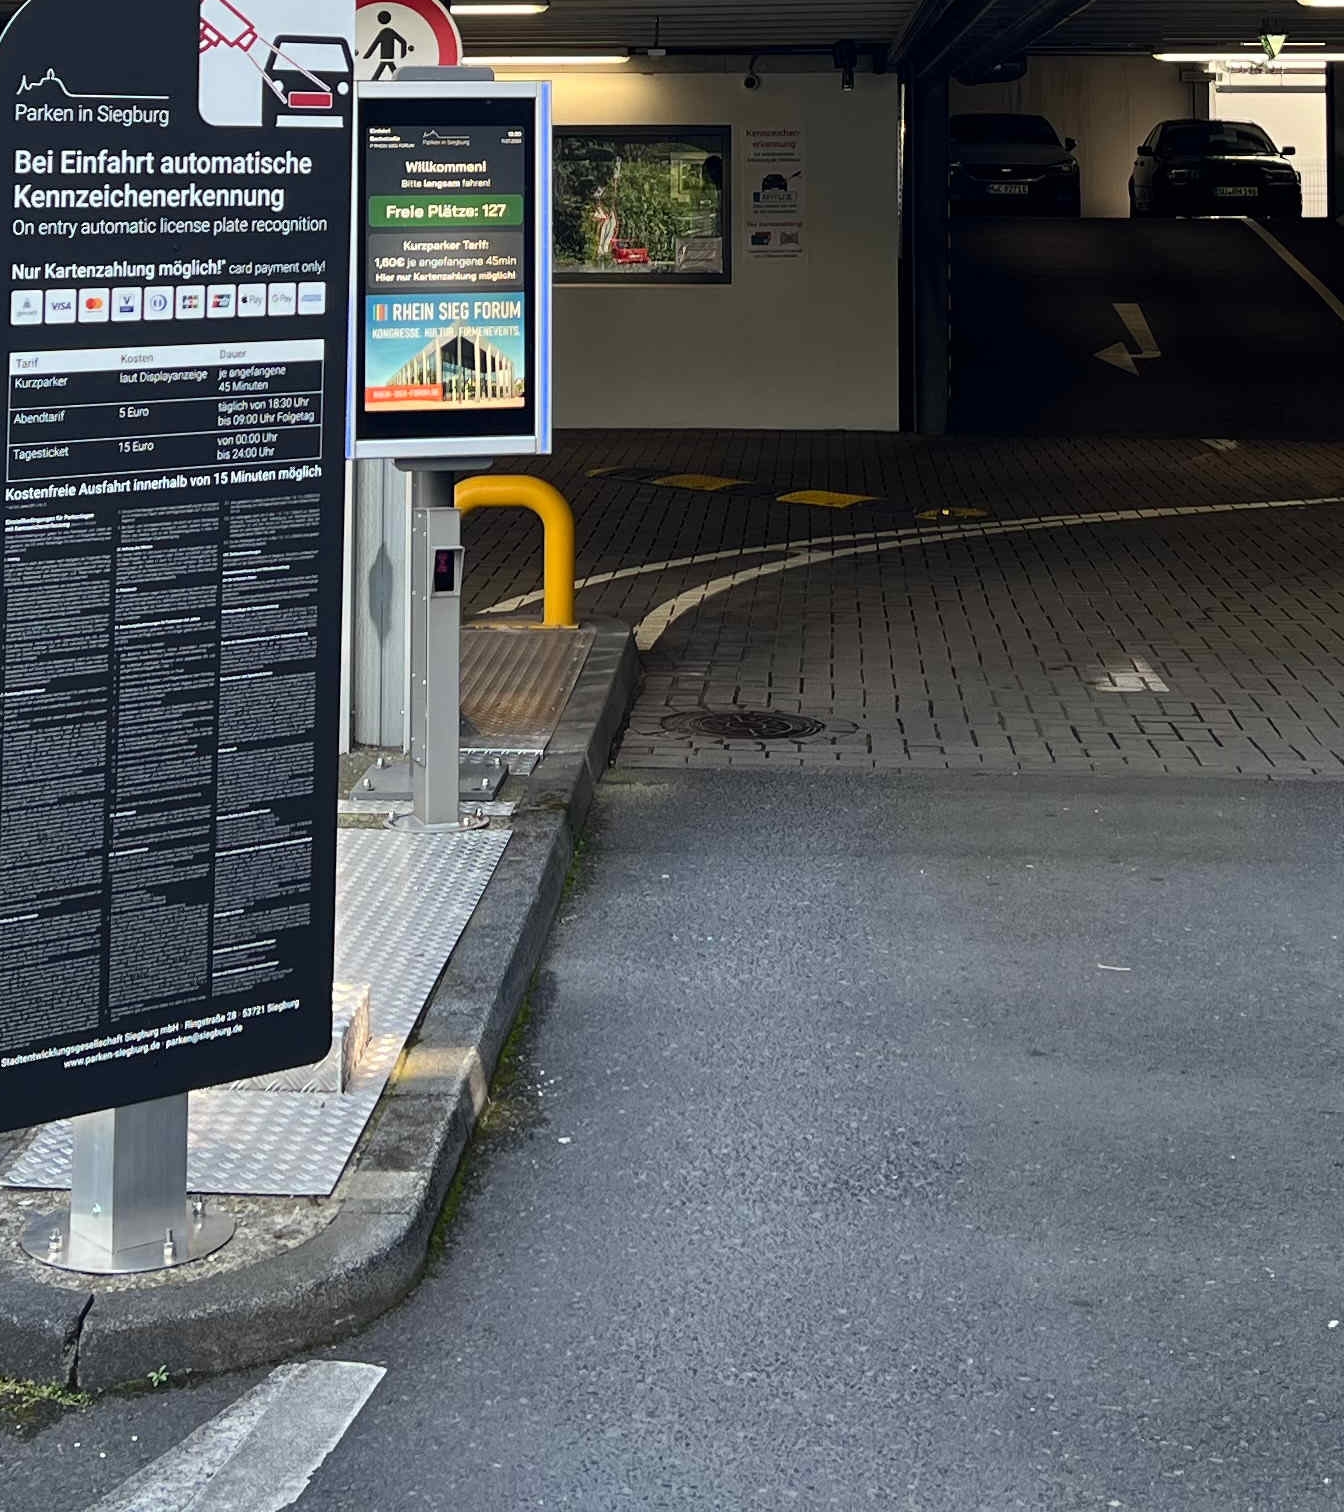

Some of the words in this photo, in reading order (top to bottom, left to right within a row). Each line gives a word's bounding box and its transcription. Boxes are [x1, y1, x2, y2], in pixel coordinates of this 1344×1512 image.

[15, 104, 74, 122] Parken
[78, 105, 93, 122] in
[97, 104, 169, 126] Siegburg
[14, 150, 53, 174] Bei
[60, 149, 154, 174] Einfahrt
[160, 151, 312, 174] automatische
[405, 160, 487, 173] Willkommen!
[401, 179, 422, 188] Bitte
[423, 179, 460, 189] langsam
[462, 179, 491, 188] fahren!
[13, 183, 285, 211] Kennzeichenerkennung
[386, 205, 424, 219] Freie
[428, 203, 479, 218] Plätze:
[482, 203, 506, 217] 127
[13, 220, 35, 235] On
[38, 221, 78, 238] entry
[81, 218, 156, 235] automatic
[160, 218, 210, 233] license
[213, 217, 248, 236] plate
[251, 216, 327, 236] recognition
[403, 240, 461, 252] Kurzparker
[463, 240, 489, 251] Tarif:
[11, 263, 41, 280] Nur
[44, 261, 155, 280] Kartenzahlung
[229, 261, 253, 275] card
[254, 261, 300, 276] payment
[302, 260, 326, 275] only!
[374, 257, 405, 269] 1,60€
[406, 257, 417, 269] je
[419, 256, 483, 269] angefangene
[485, 255, 517, 266] 45min
[376, 273, 395, 282] Hier
[397, 274, 411, 282] nur
[413, 271, 477, 283] Kartenzahlung
[479, 270, 516, 282] möglich!
[51, 302, 72, 311] VISA
[249, 294, 263, 306] Pay
[392, 303, 434, 321] RHEIN
[438, 302, 469, 320] SIEG
[474, 301, 521, 320] FORUM
[15, 357, 39, 370] Tarif
[120, 352, 155, 365] Kosten
[219, 348, 247, 361] Dauer
[14, 375, 68, 390] Kurzparker
[119, 372, 137, 384] laut
[139, 368, 209, 386] Displayanzeige
[217, 368, 227, 381] je
[229, 364, 287, 380] angefangene
[218, 381, 230, 393] 45
[232, 379, 269, 392] Minuten
[13, 410, 66, 425] Abendtarif
[119, 407, 126, 419] 5
[127, 405, 150, 419] Euro
[218, 399, 248, 415] täglich
[249, 399, 266, 411] von
[294, 396, 310, 408] Uhr
[217, 415, 232, 427] bis
[259, 411, 276, 424] Uhr
[277, 408, 315, 424] Folgetag
[13, 446, 70, 462] Tagesticket
[118, 441, 131, 454] 15
[132, 440, 154, 453] Euro
[217, 436, 234, 447] von
[262, 431, 278, 444] Uhr
[217, 449, 231, 461] bis
[258, 445, 275, 458] Uhr
[5, 484, 77, 502] Kostenfreie
[78, 478, 131, 498] Ausfahrt
[133, 474, 188, 494] innerhalb
[190, 474, 211, 489] von
[213, 471, 229, 486] 15
[230, 467, 275, 485] Minuten
[278, 463, 323, 484] möglich
[124, 1027, 159, 1043] Siegburg
[160, 1022, 179, 1035] mbH
[267, 999, 300, 1014] Siegburg
